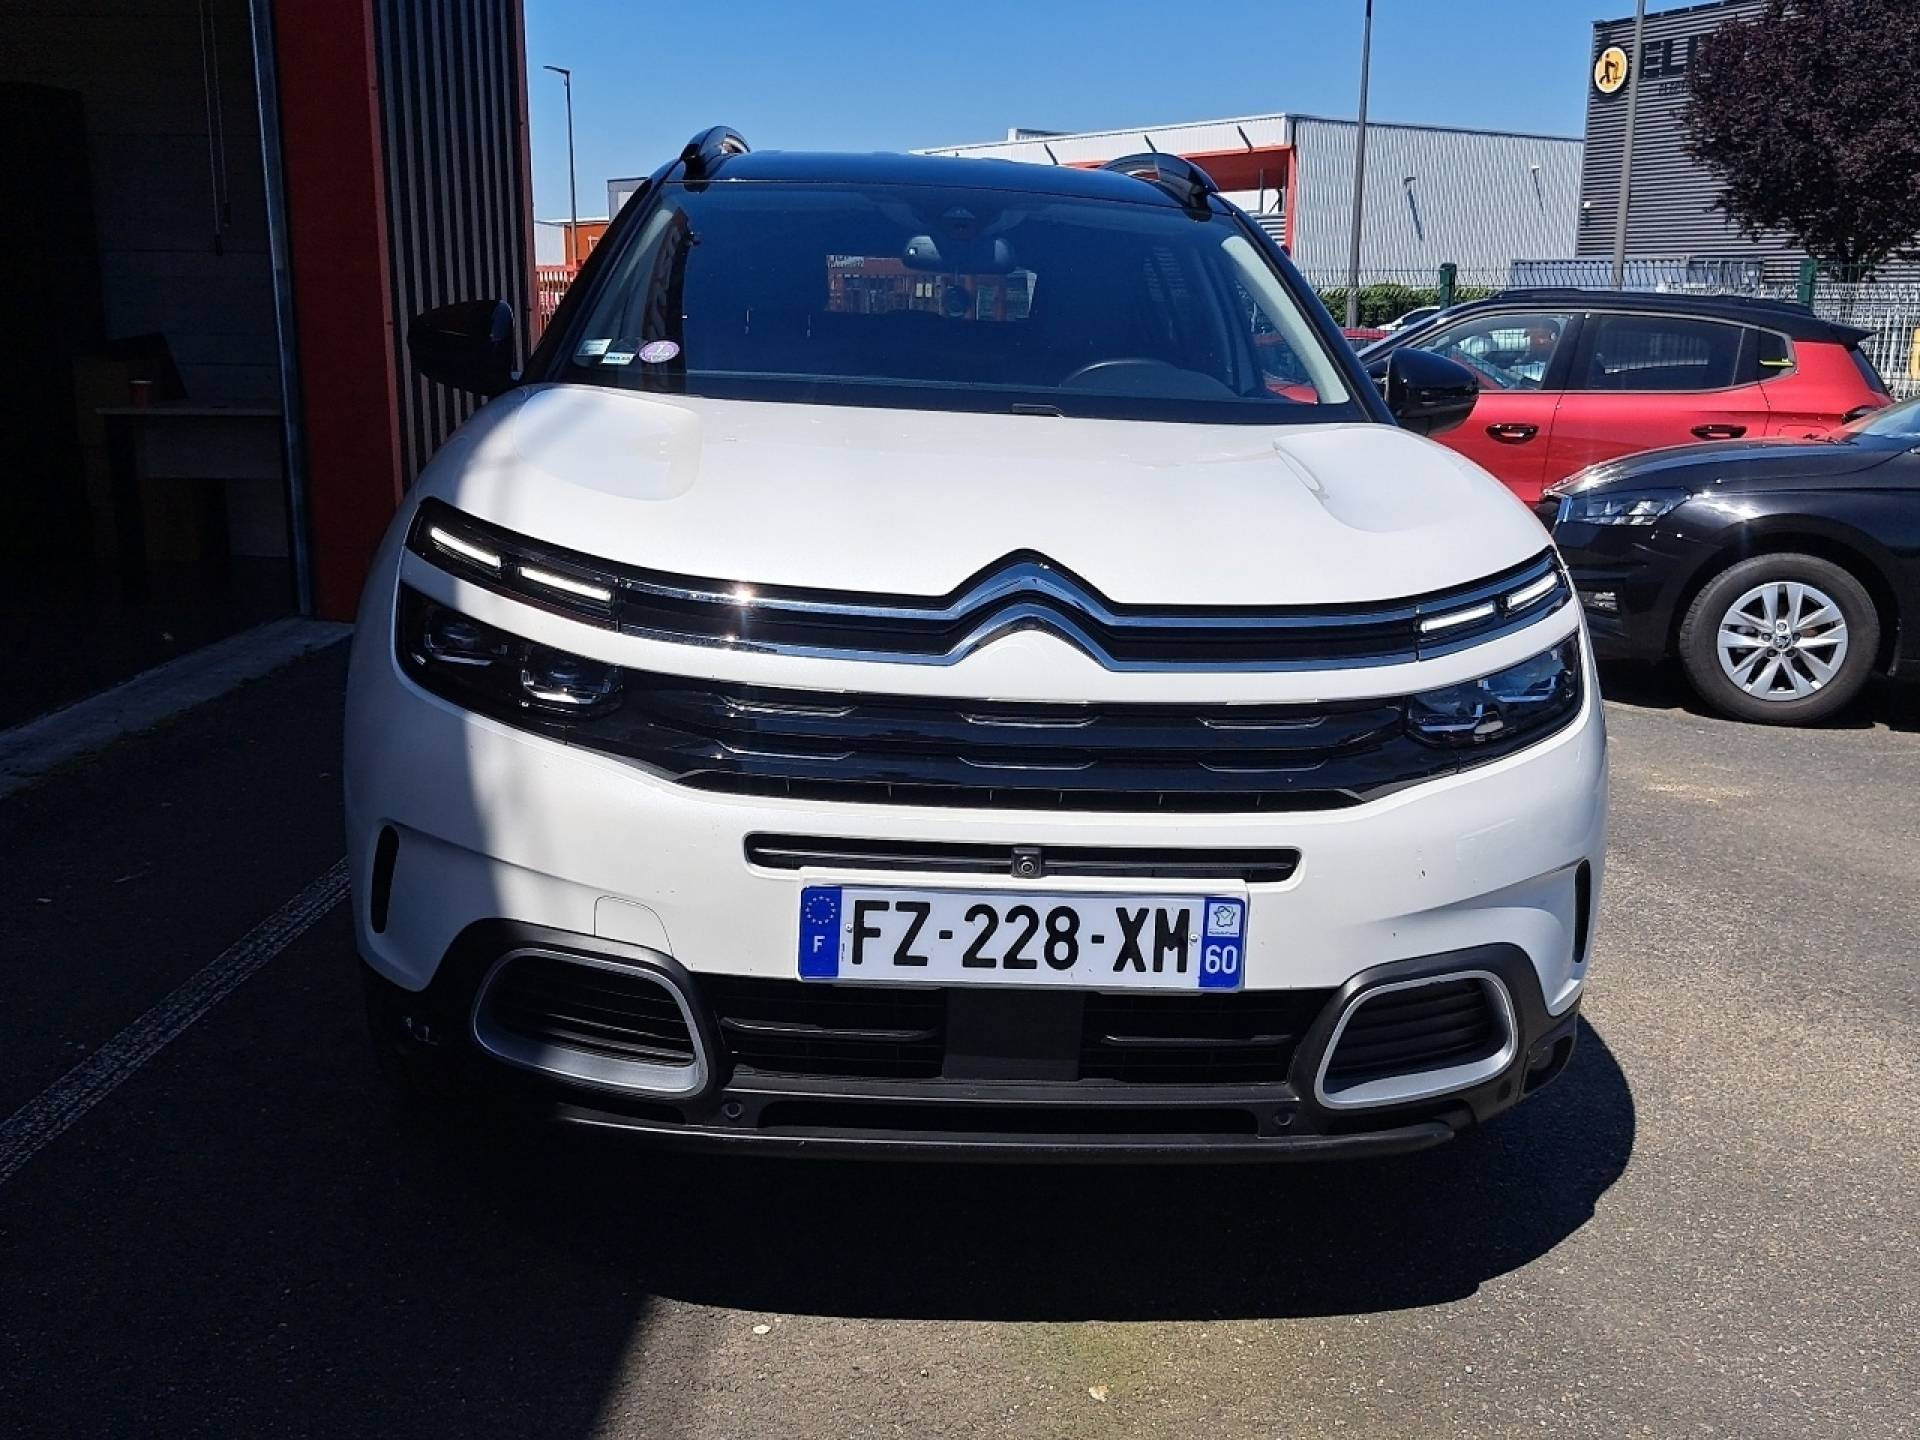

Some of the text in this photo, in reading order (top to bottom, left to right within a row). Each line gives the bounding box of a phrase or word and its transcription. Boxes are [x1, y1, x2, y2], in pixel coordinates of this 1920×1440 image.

[812, 935, 826, 954] F
[851, 899, 1190, 973] FZ-228-XM
[1205, 944, 1238, 975] 60
